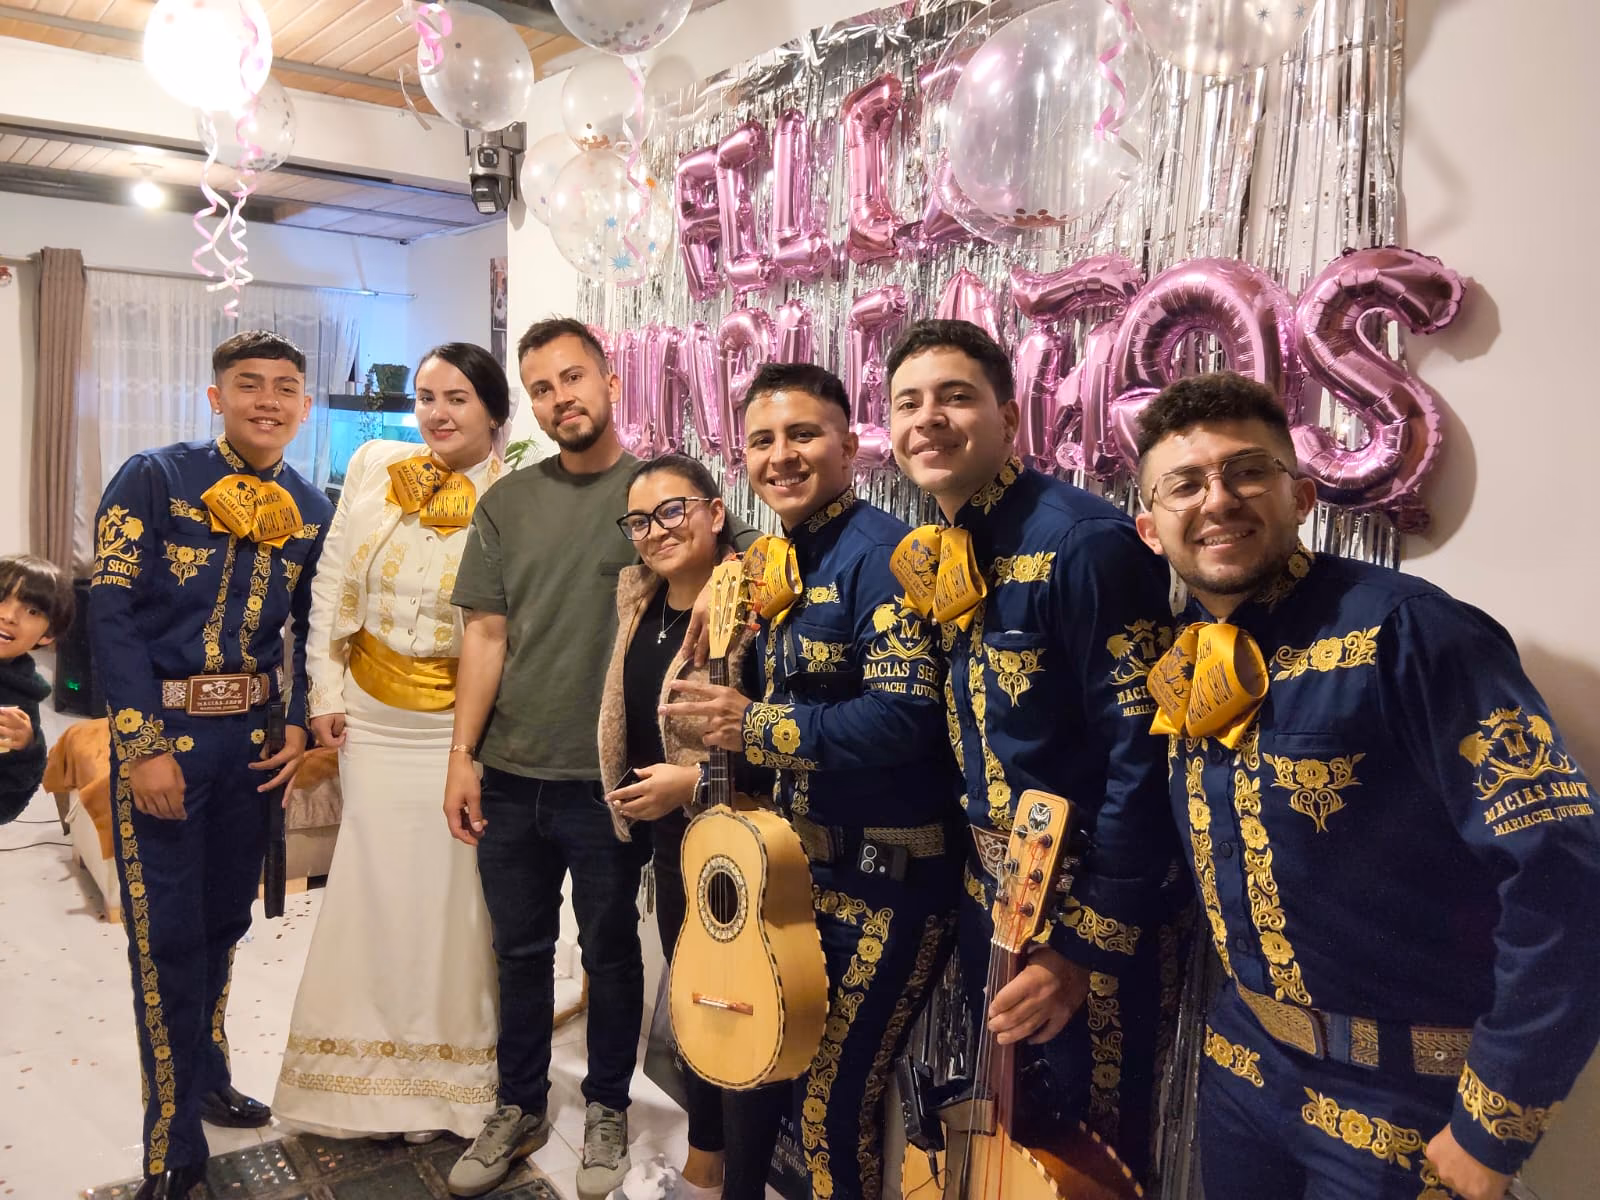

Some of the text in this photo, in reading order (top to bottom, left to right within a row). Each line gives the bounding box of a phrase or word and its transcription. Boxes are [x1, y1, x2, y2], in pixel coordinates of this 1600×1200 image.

[863, 661, 939, 686] MACIAS SHO
[1116, 685, 1150, 705] MACI
[1483, 781, 1590, 824] MACIAS SHOW
[1492, 803, 1594, 836] MARIACHI JUVENIL
